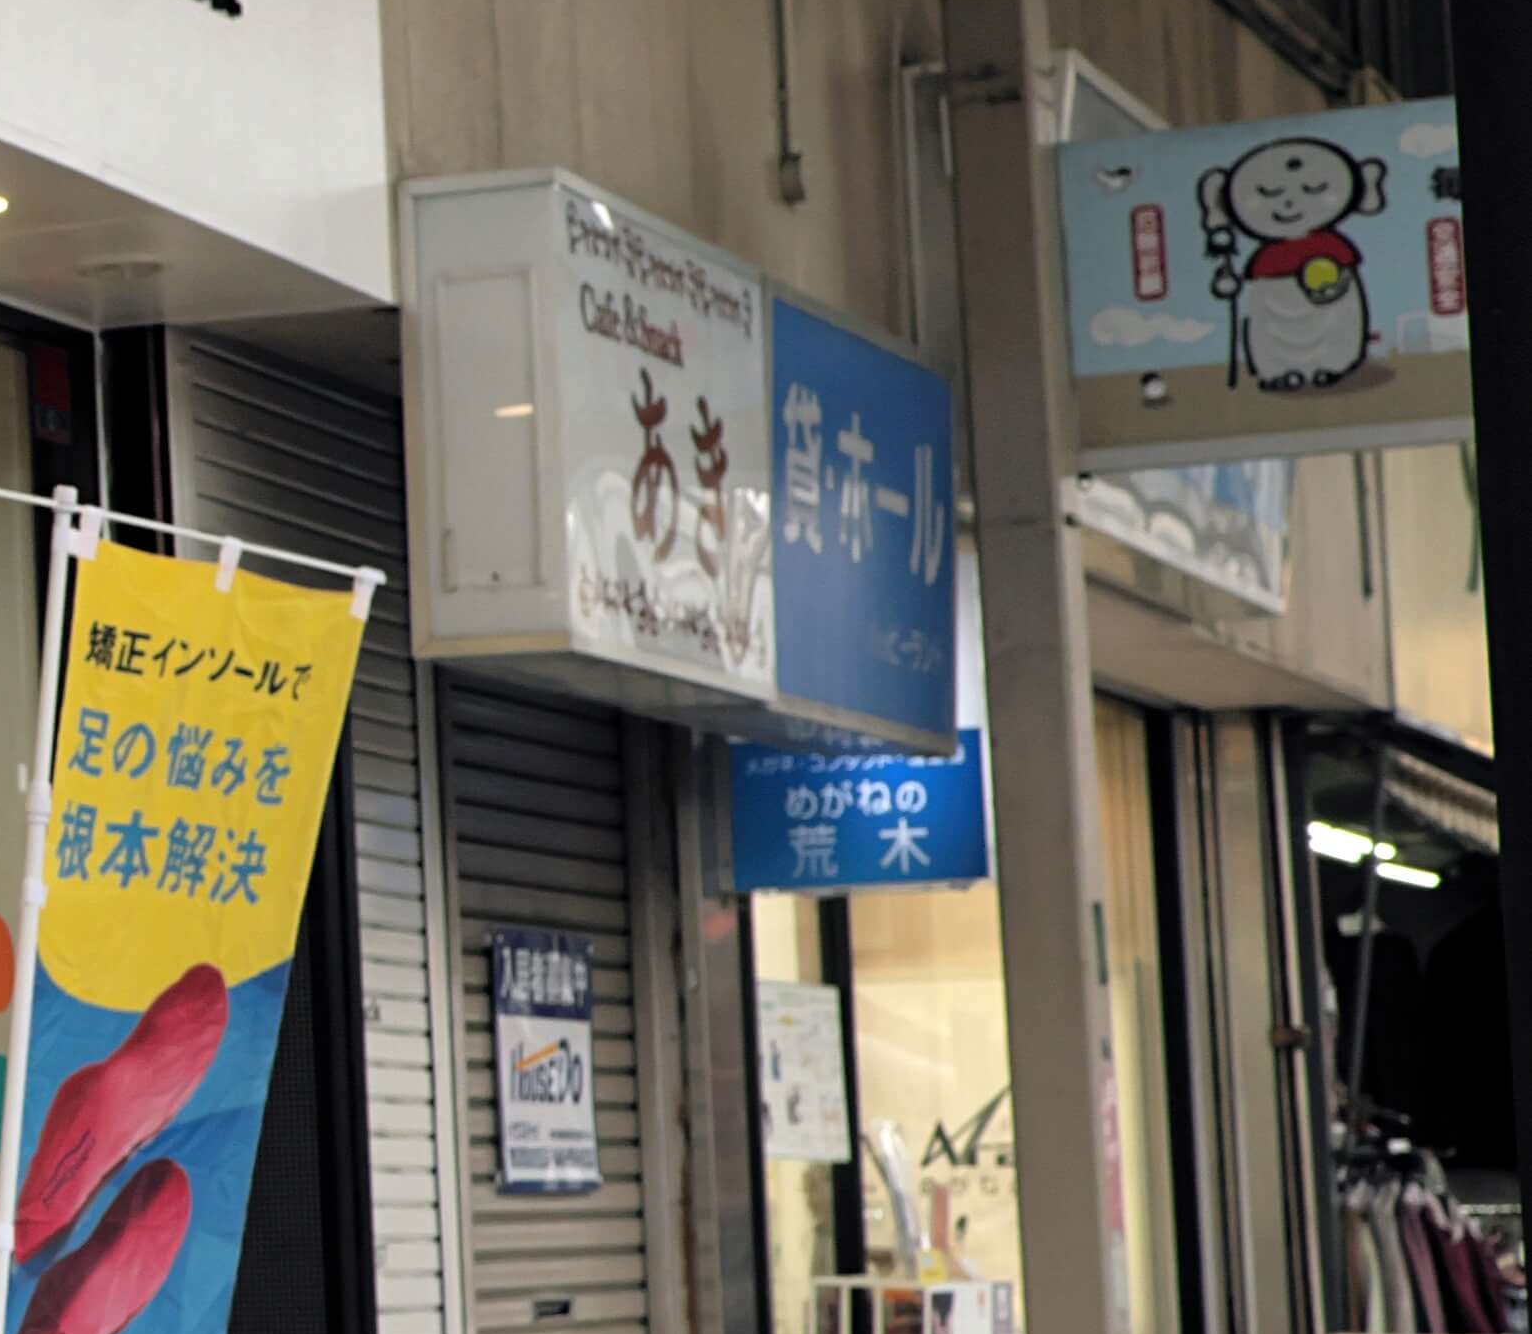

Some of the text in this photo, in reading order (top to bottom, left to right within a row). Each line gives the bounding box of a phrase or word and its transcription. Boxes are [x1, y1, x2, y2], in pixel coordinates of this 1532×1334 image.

[631, 368, 730, 576] あき
[84, 620, 314, 702] 矯正インソールで
[68, 707, 291, 805] 足の悩みを
[785, 778, 929, 822] めがねの
[55, 800, 269, 906] 根本解決
[789, 818, 933, 879] 荒木
